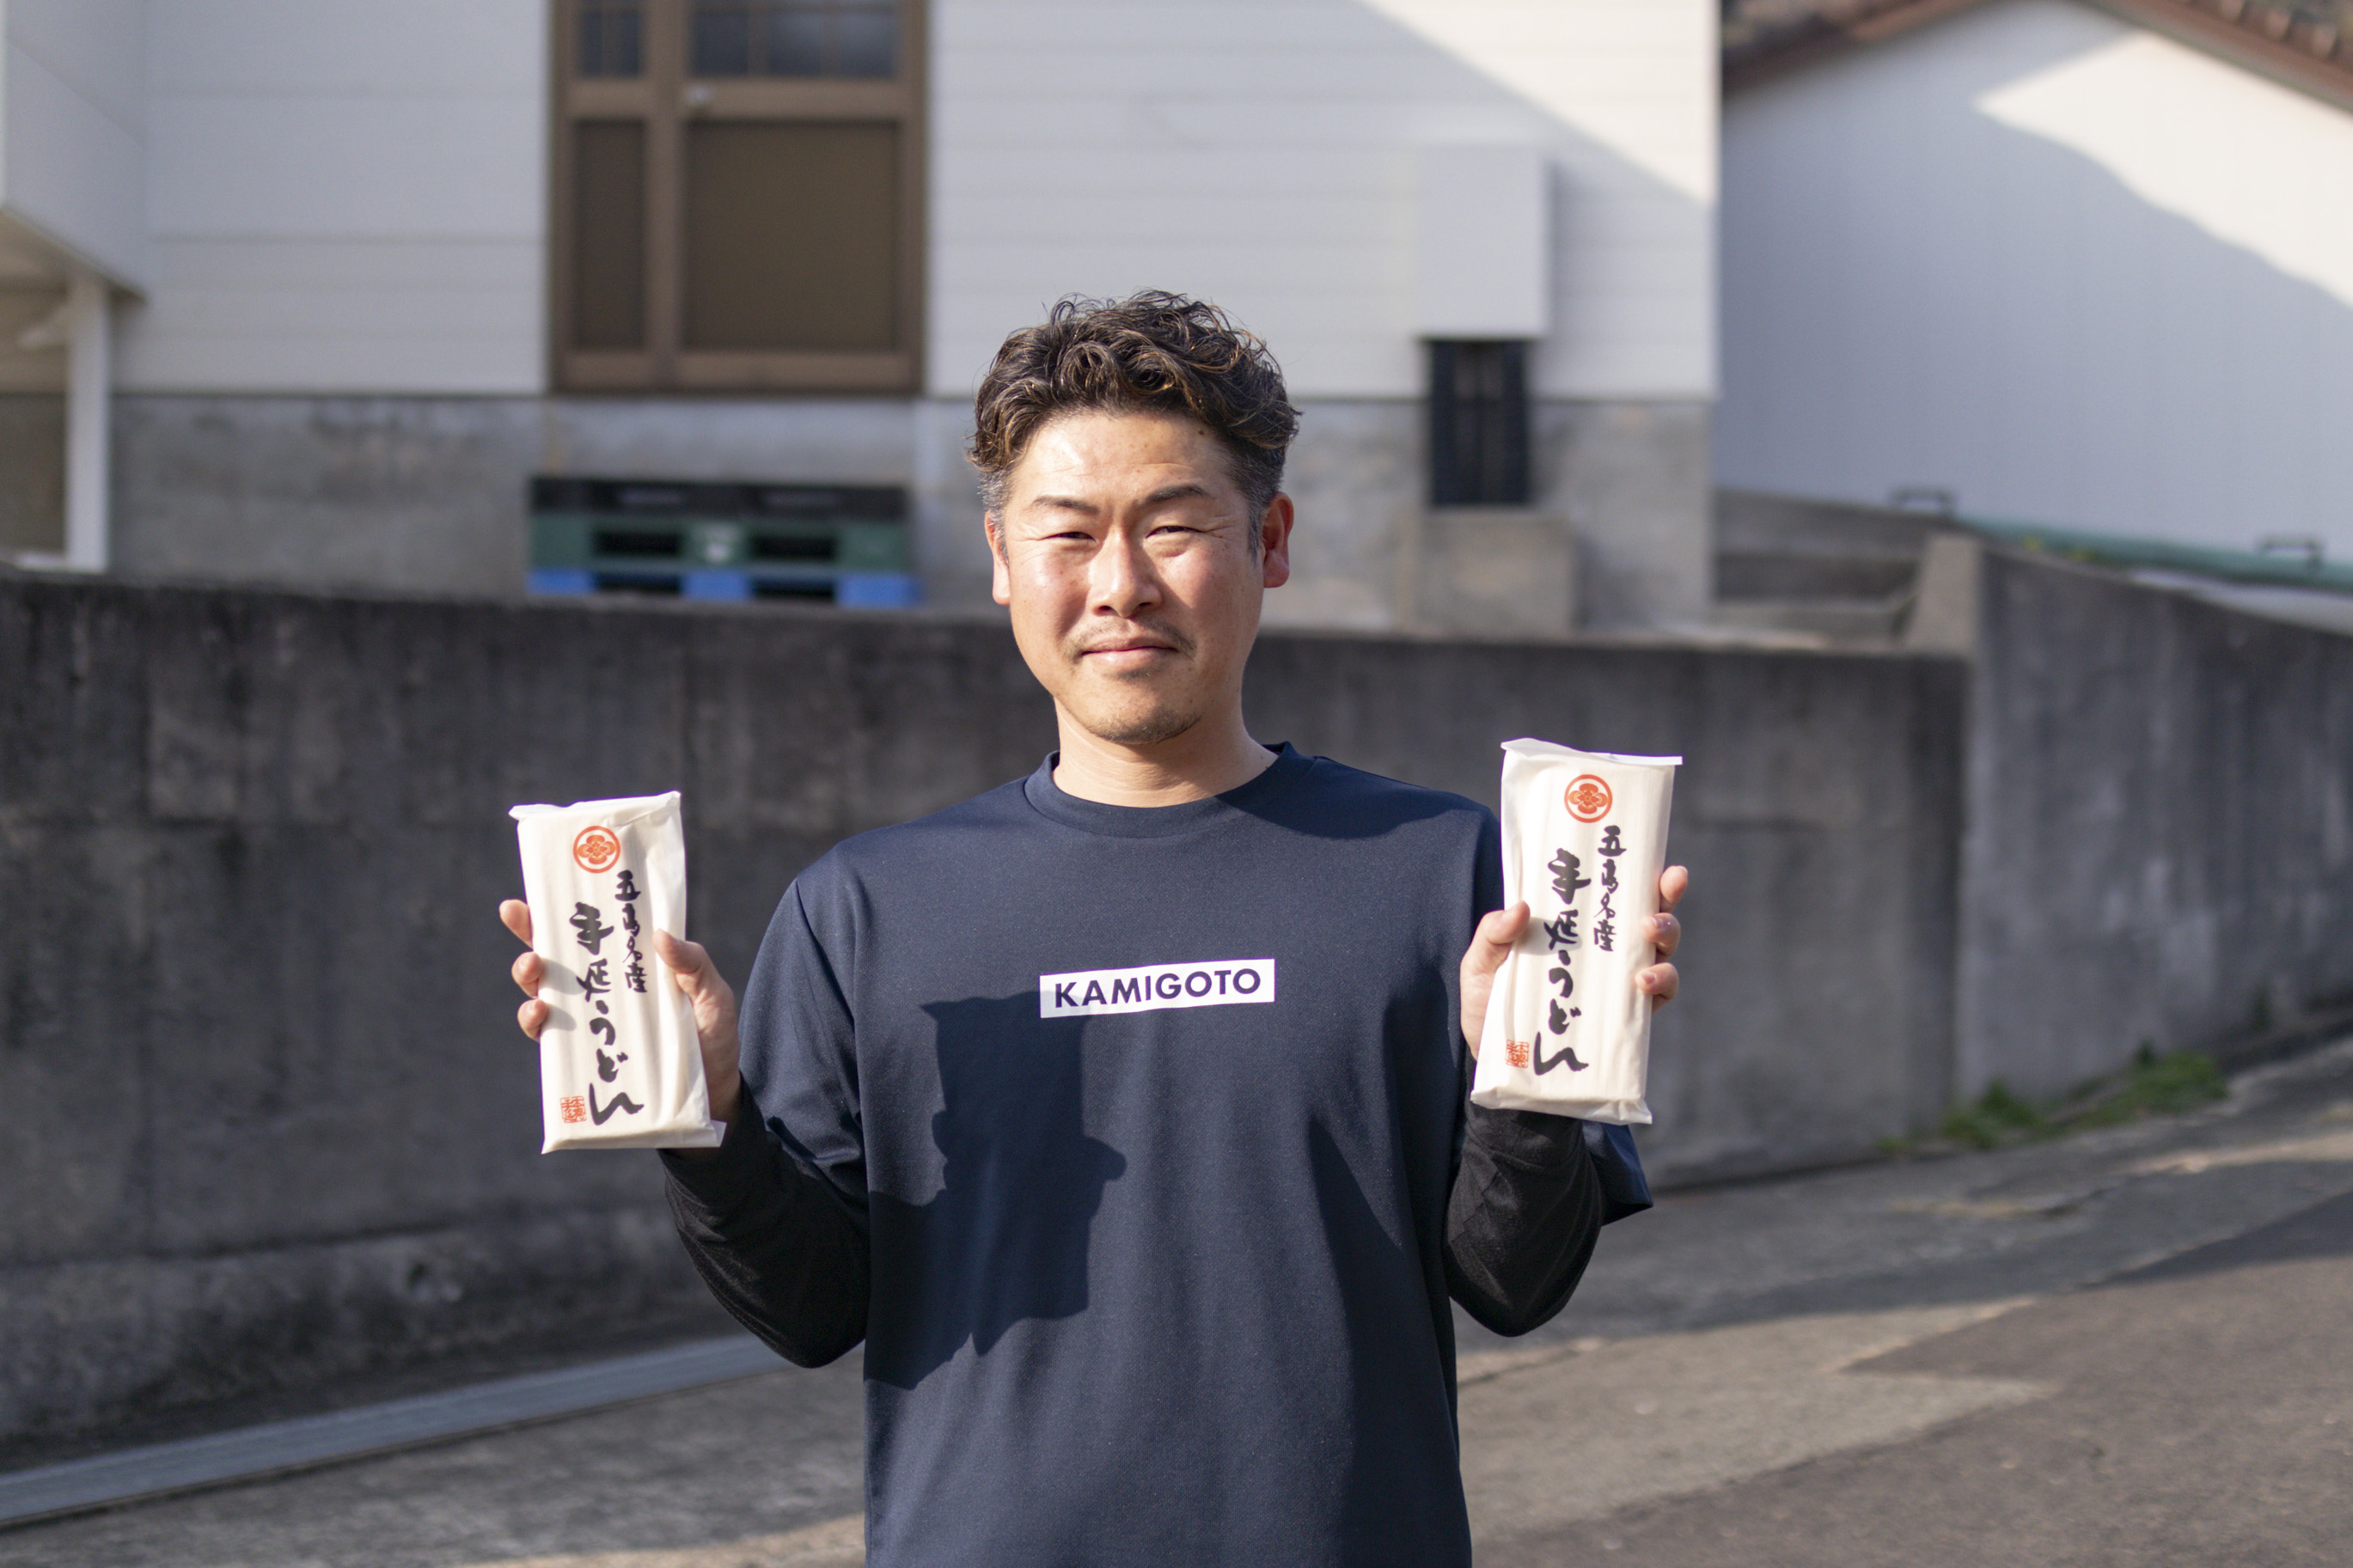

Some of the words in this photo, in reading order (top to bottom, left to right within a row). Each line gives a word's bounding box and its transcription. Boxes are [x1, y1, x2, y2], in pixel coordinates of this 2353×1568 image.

[569, 901, 644, 1126] 手延うどん
[1055, 968, 1261, 1008] KAMIGOTO
[1533, 847, 1592, 1076] 手延うどん
